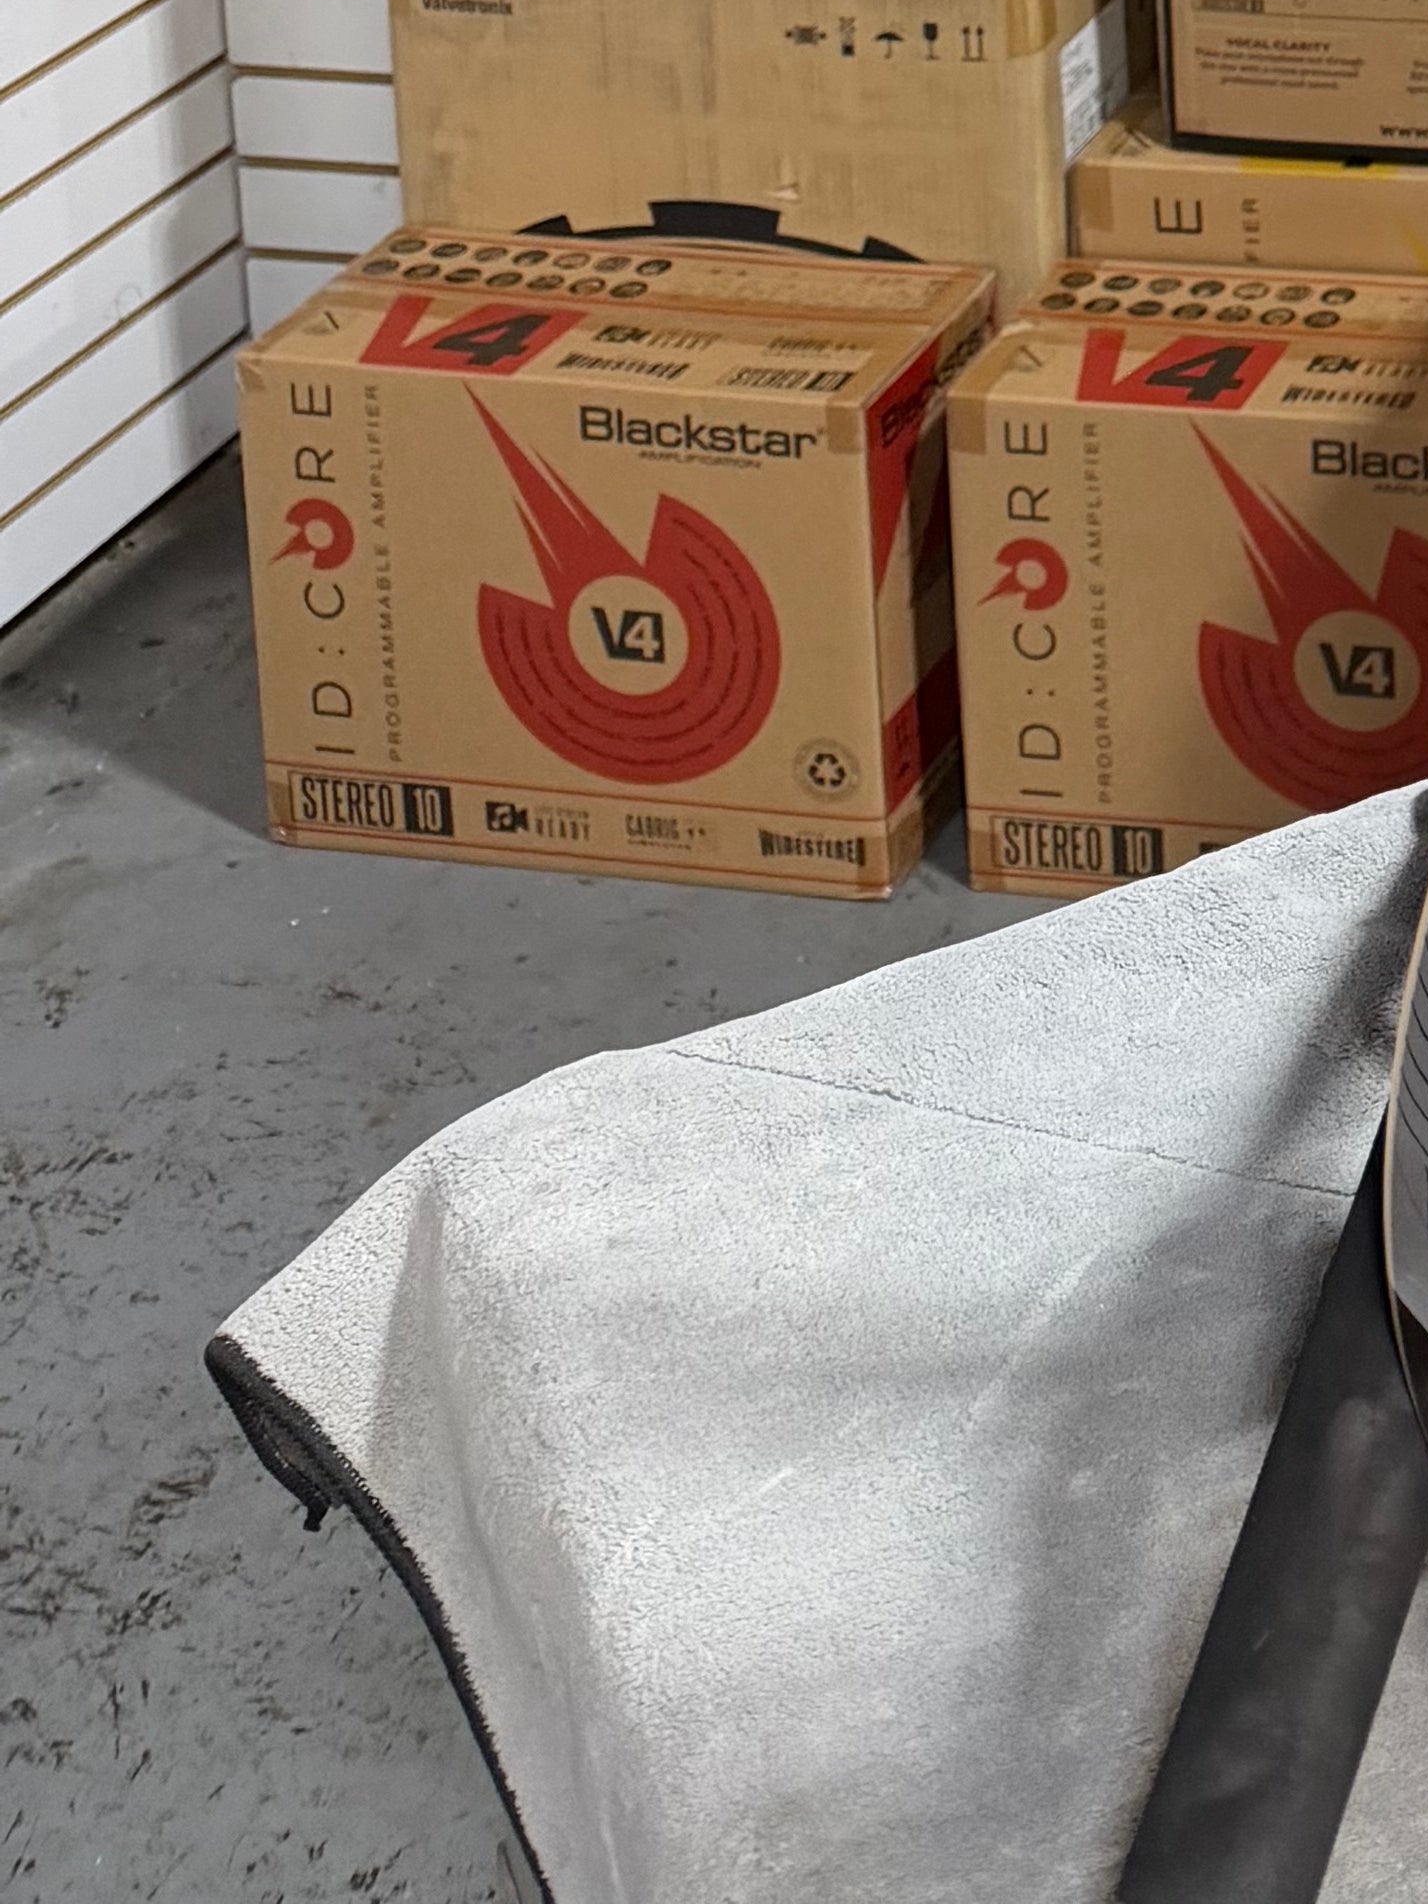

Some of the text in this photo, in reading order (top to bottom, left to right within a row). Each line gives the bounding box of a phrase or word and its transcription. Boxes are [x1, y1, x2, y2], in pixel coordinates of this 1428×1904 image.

[579, 405, 818, 459] Blackstar
[363, 384, 403, 763] PROGRAMMABLE AMPLIFIER
[591, 605, 666, 665] V4
[1082, 421, 1114, 805] PROGRAMMABLE AMPLIFIER
[1319, 642, 1396, 700] V4
[301, 776, 449, 836] STEREO 10
[1002, 820, 1157, 876] STEREO 10
